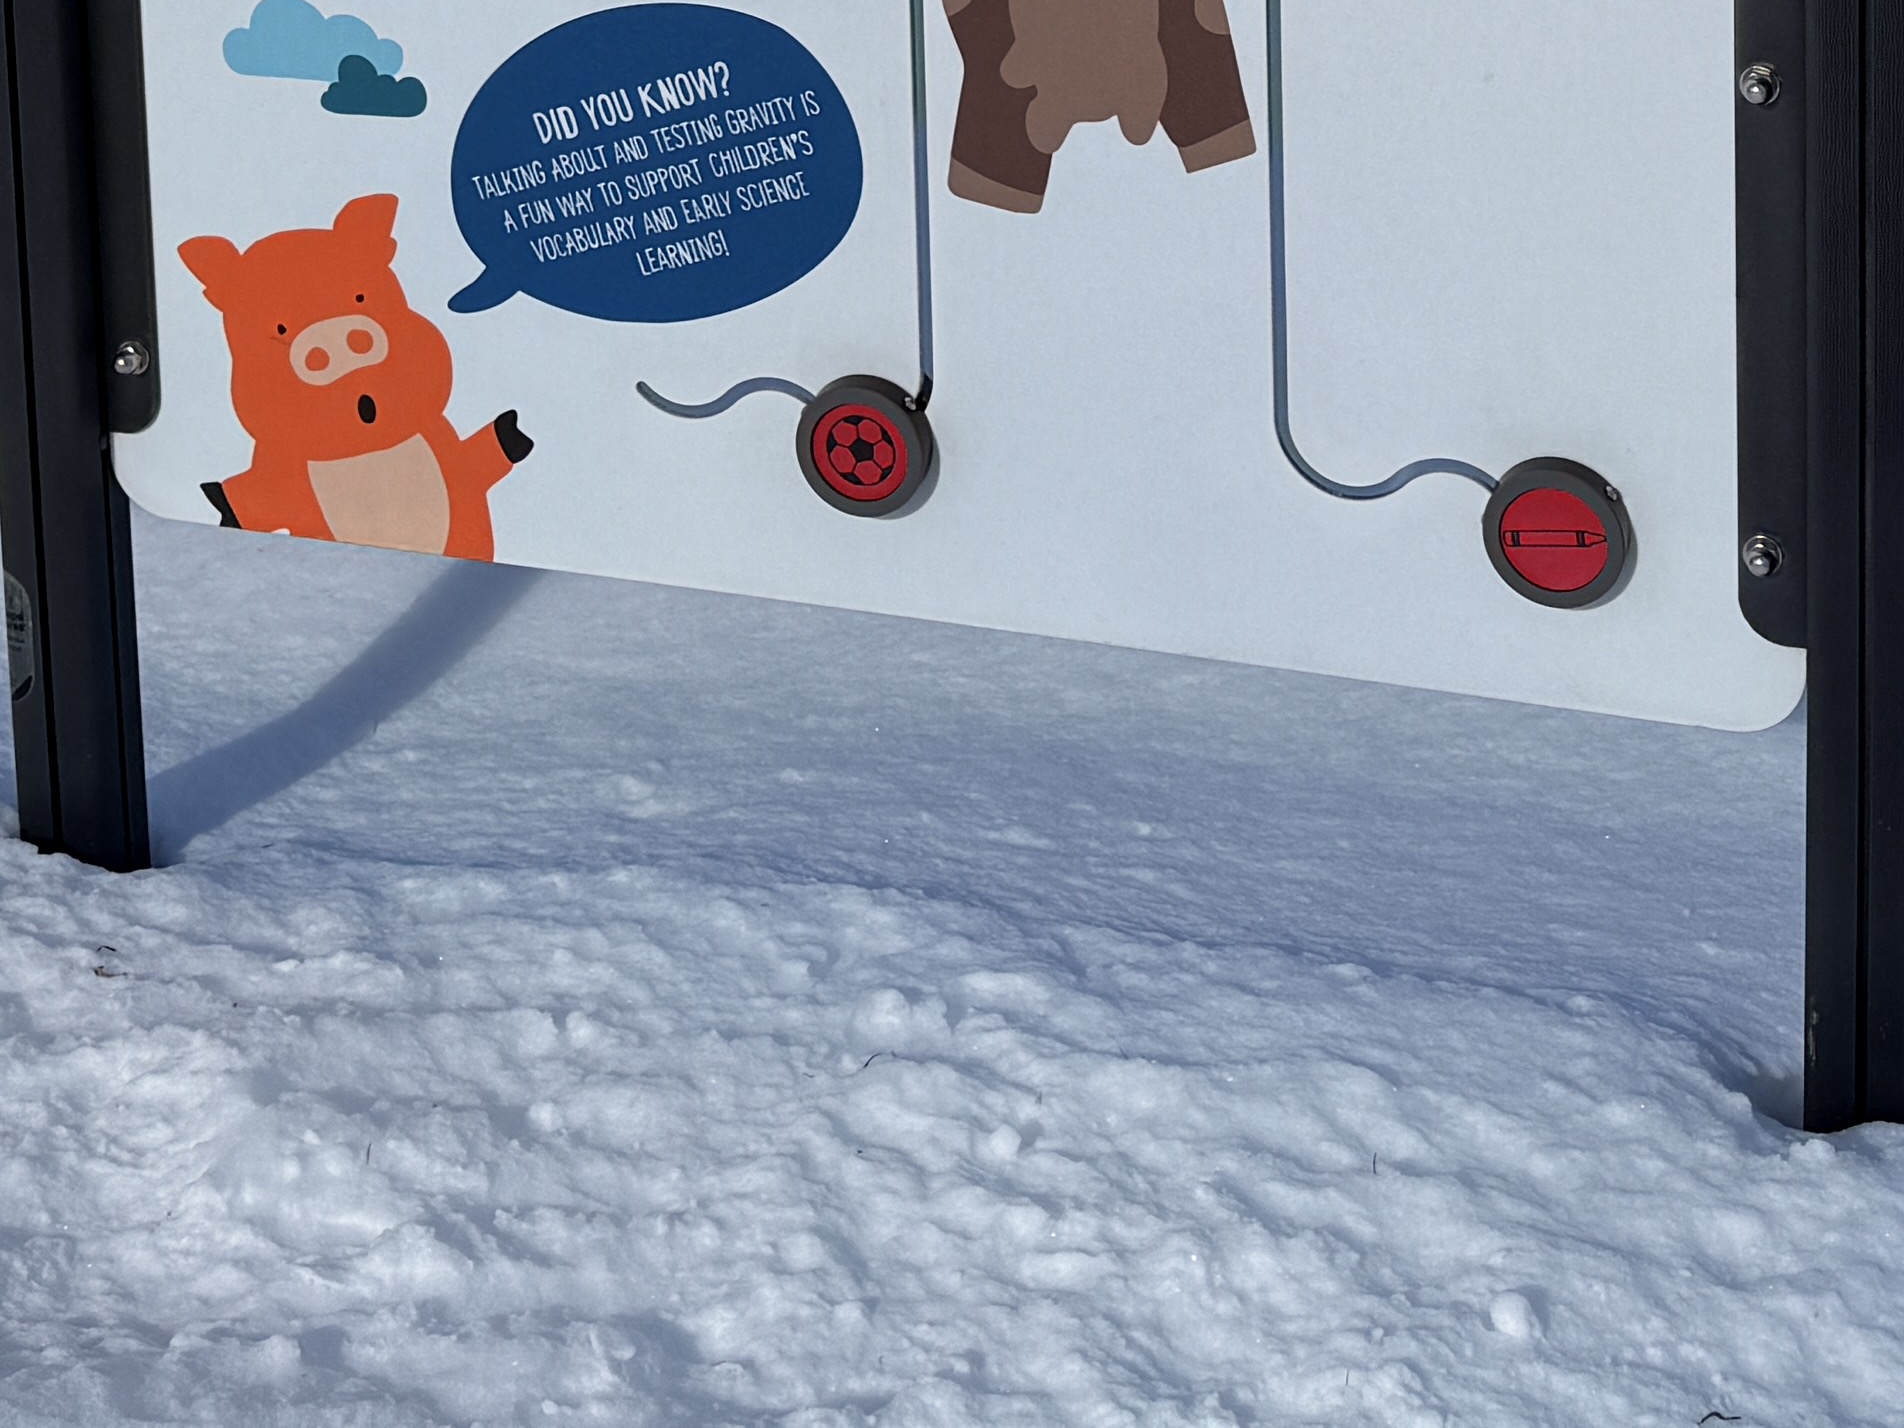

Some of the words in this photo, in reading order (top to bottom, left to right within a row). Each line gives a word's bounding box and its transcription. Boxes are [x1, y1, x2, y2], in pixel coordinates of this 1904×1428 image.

[472, 160, 546, 200] TALKING
[551, 144, 608, 183] ABOUT
[613, 135, 649, 165] AND
[650, 113, 724, 154] TESTING
[725, 96, 796, 135] GRAVITY
[800, 90, 821, 117] IS
[532, 105, 579, 145] DID
[580, 88, 635, 131] YOU
[638, 61, 730, 119] KNOW?
[504, 209, 519, 234] A
[518, 198, 555, 229] FUN
[555, 187, 594, 218] WAY
[596, 180, 623, 207] TO
[625, 158, 703, 200] SUPPORT
[529, 215, 637, 263] VOCABULARY
[643, 205, 679, 236] AND
[680, 190, 732, 224] EARLY
[736, 171, 810, 212] SCIENCE
[636, 229, 730, 276] LEARNING!
